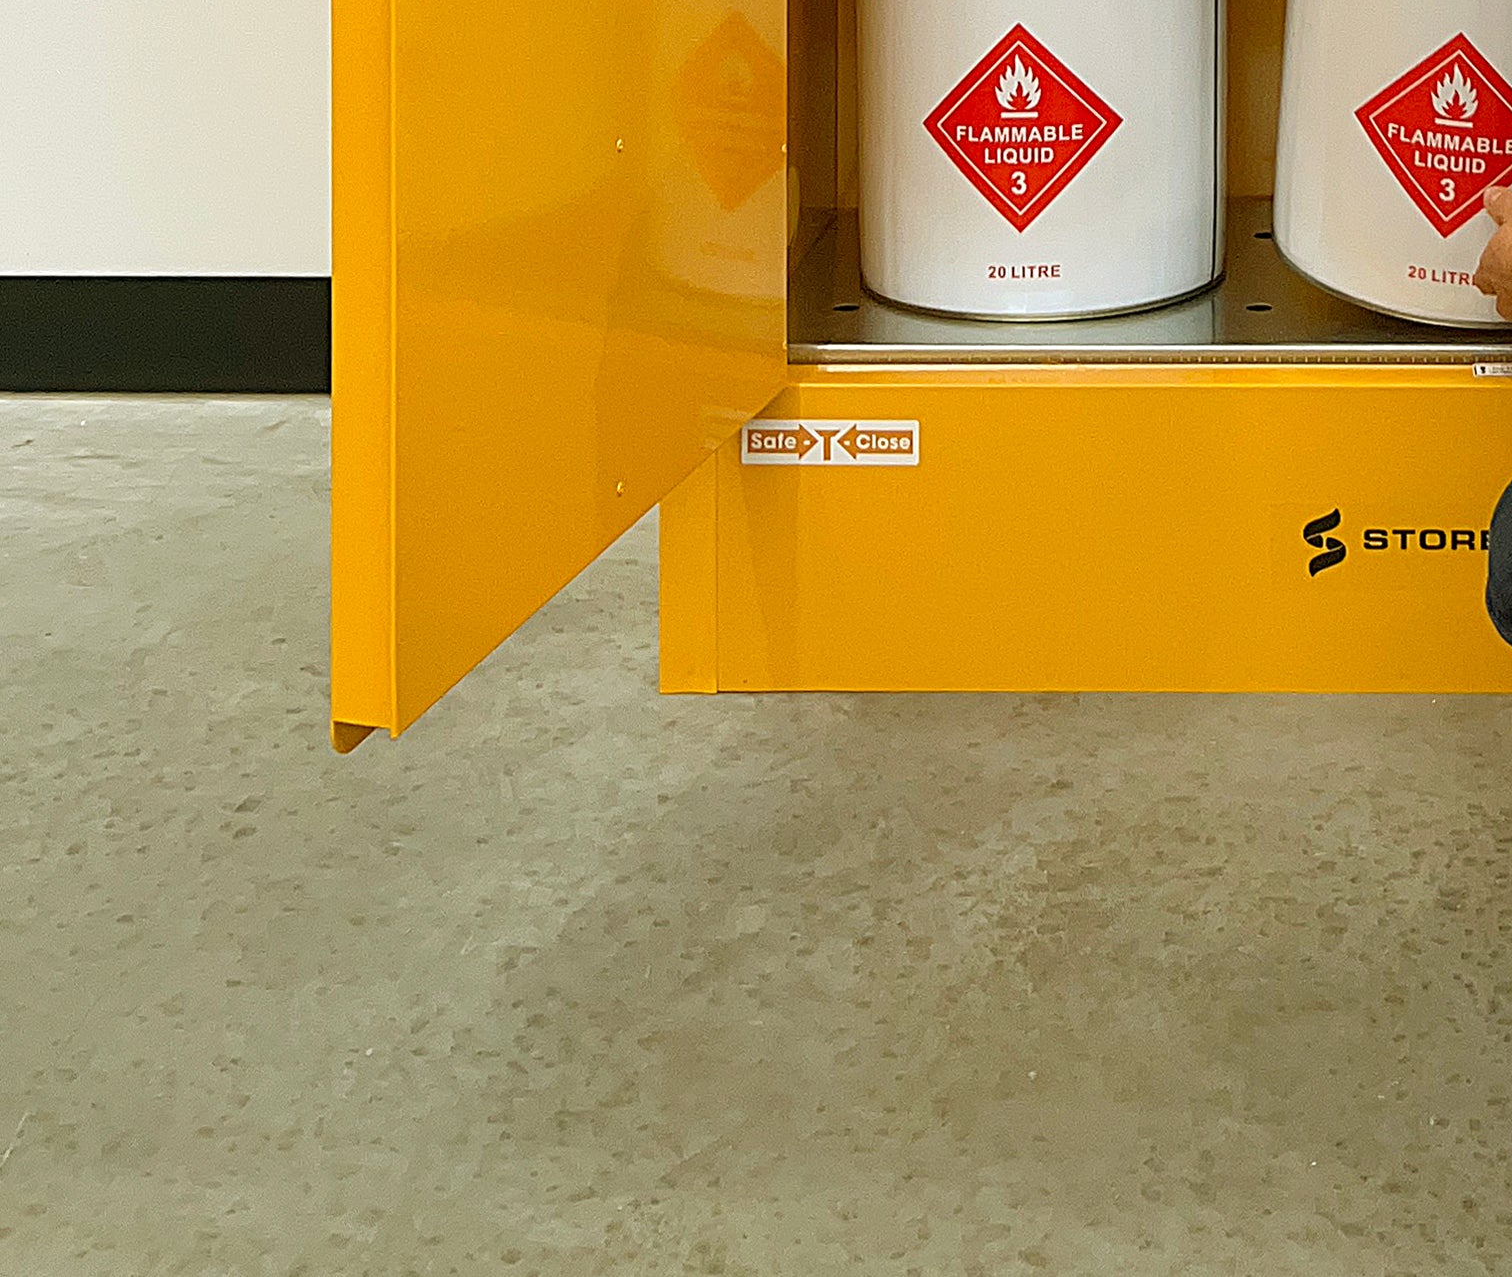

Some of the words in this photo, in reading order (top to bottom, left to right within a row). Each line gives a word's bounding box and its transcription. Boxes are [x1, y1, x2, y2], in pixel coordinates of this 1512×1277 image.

[956, 124, 1084, 143] FLAMMABLE
[984, 147, 1055, 164] LIQUID
[1413, 150, 1486, 174] LIQUID
[1010, 171, 1027, 195] 3
[1439, 178, 1456, 202] 3
[988, 266, 1006, 279] 20
[1011, 265, 1061, 279] LITRE
[1407, 265, 1427, 280] 20
[751, 432, 797, 449] Safe
[856, 433, 911, 450] Close
